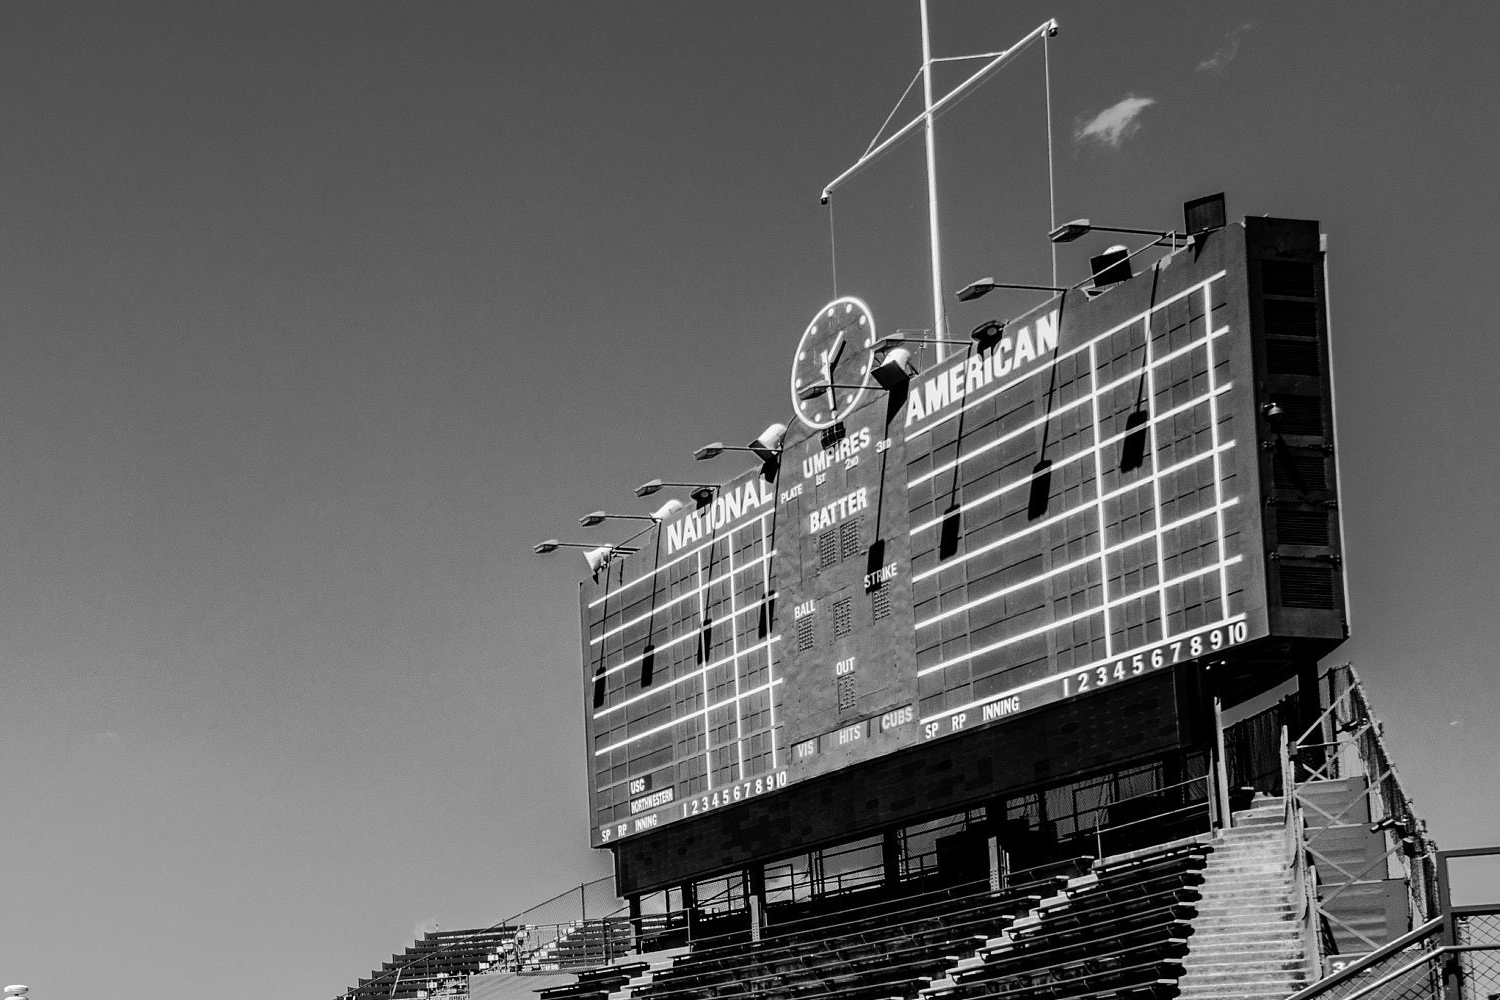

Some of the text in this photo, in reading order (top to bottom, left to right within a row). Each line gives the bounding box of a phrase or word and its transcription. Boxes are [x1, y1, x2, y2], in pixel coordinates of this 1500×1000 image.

[904, 309, 1058, 428] AMERICAN
[802, 427, 870, 479] UMPIRES
[844, 455, 859, 471] 2ND
[815, 473, 826, 486] 1ST
[781, 483, 803, 504] PLATE
[667, 473, 773, 555] NATIONAL
[809, 487, 869, 534] BATTER
[864, 562, 898, 589] STRIKE
[794, 600, 816, 619] BALL
[836, 657, 855, 676] OUT
[925, 621, 1247, 739] SP RP INNING 1 2 3 4 5 6 7 8 9 10
[797, 706, 913, 758] VIS HITS CUBS
[630, 778, 645, 795] USC
[601, 771, 787, 842] SP RP INNING 1 2 3 4 5 6 7 8 9 10
[631, 787, 674, 814] NORTHWESTERN
